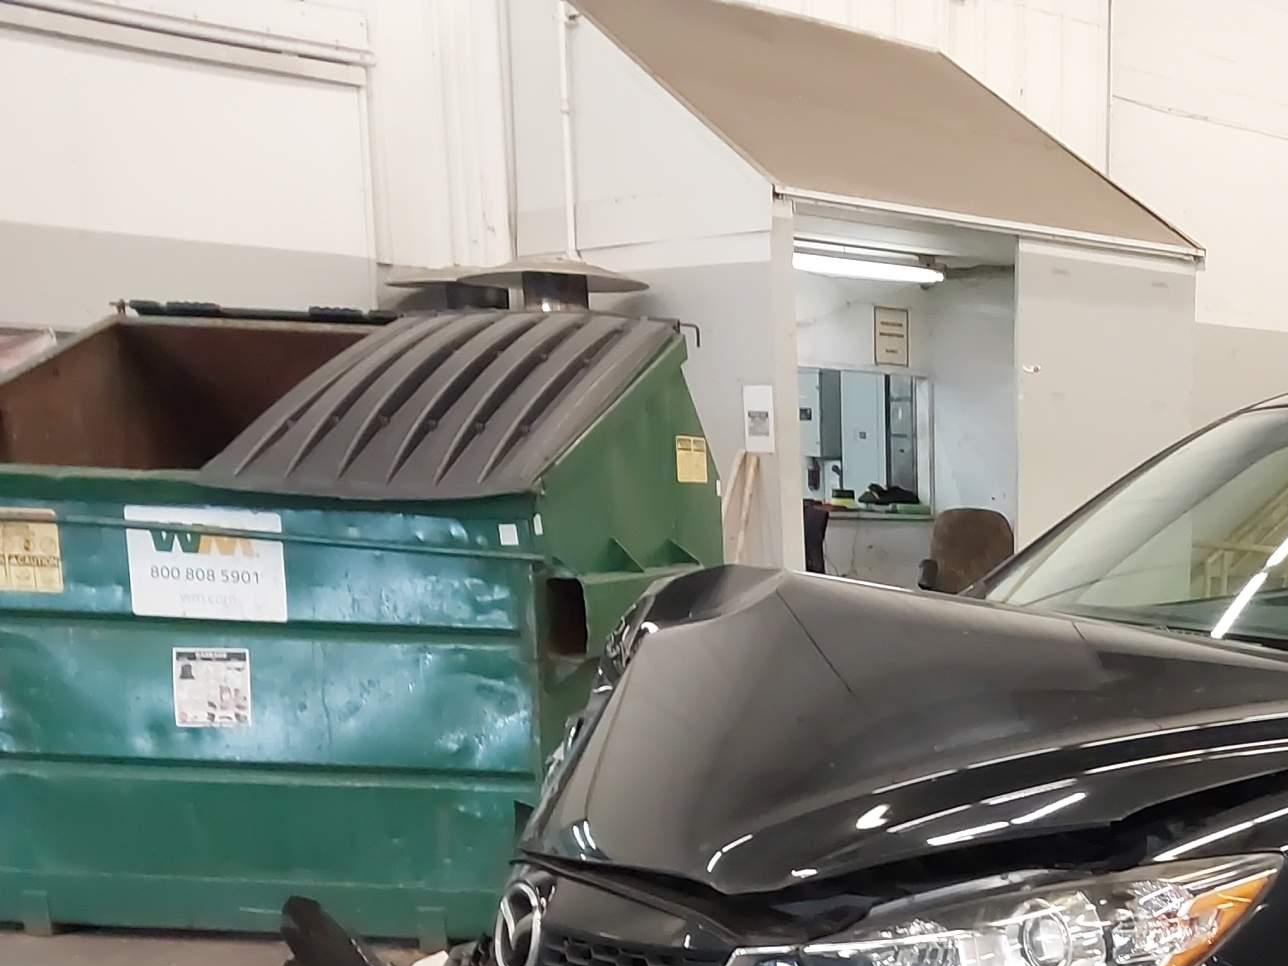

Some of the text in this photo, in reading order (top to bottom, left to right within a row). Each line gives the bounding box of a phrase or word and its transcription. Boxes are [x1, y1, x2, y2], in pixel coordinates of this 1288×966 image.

[150, 564, 260, 585] 800 808 5901
